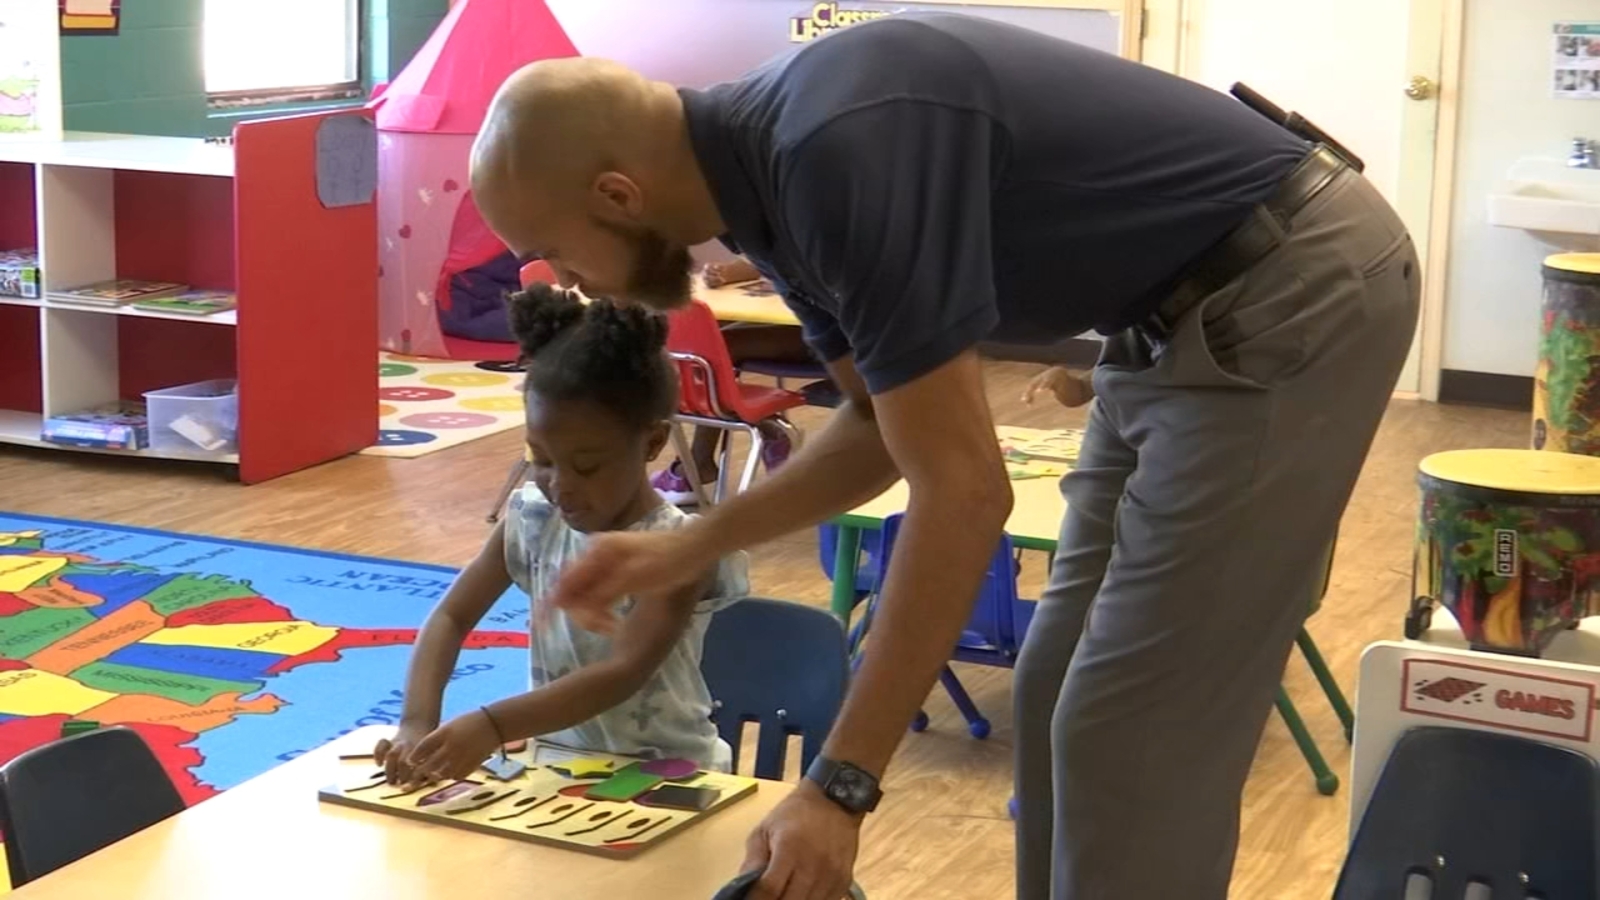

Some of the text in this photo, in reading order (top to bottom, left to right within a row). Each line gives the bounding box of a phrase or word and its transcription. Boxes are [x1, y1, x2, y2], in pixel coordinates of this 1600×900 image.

[813, 2, 881, 27] Class
[1499, 533, 1512, 572] REMO
[237, 624, 300, 648] GEORGIA
[1494, 689, 1576, 720] GAMES
